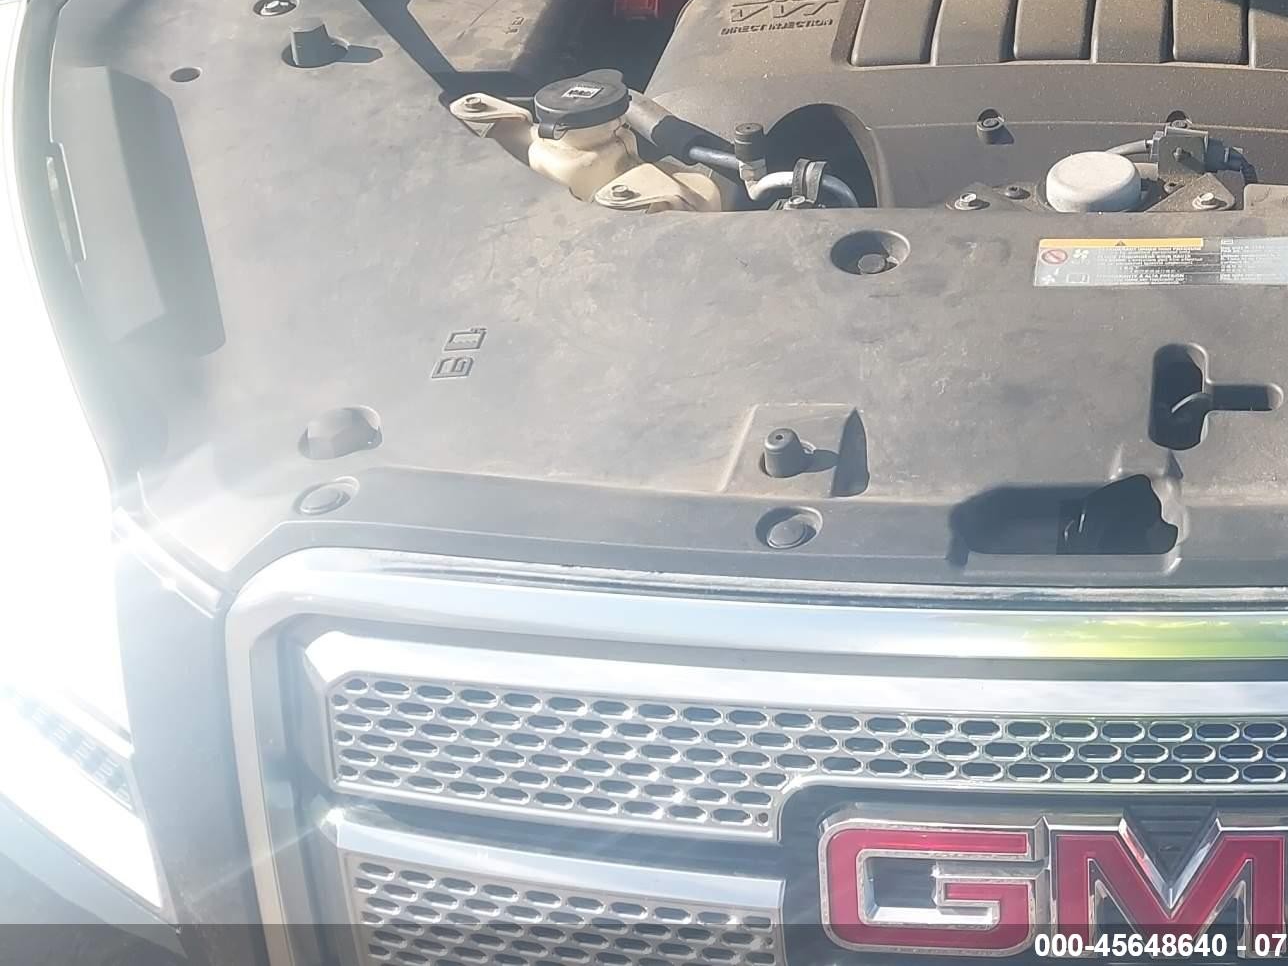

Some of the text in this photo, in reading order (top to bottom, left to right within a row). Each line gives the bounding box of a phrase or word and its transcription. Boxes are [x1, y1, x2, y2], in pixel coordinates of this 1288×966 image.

[730, 0, 839, 22] VVT
[720, 19, 834, 35] DIRECT INJECTION
